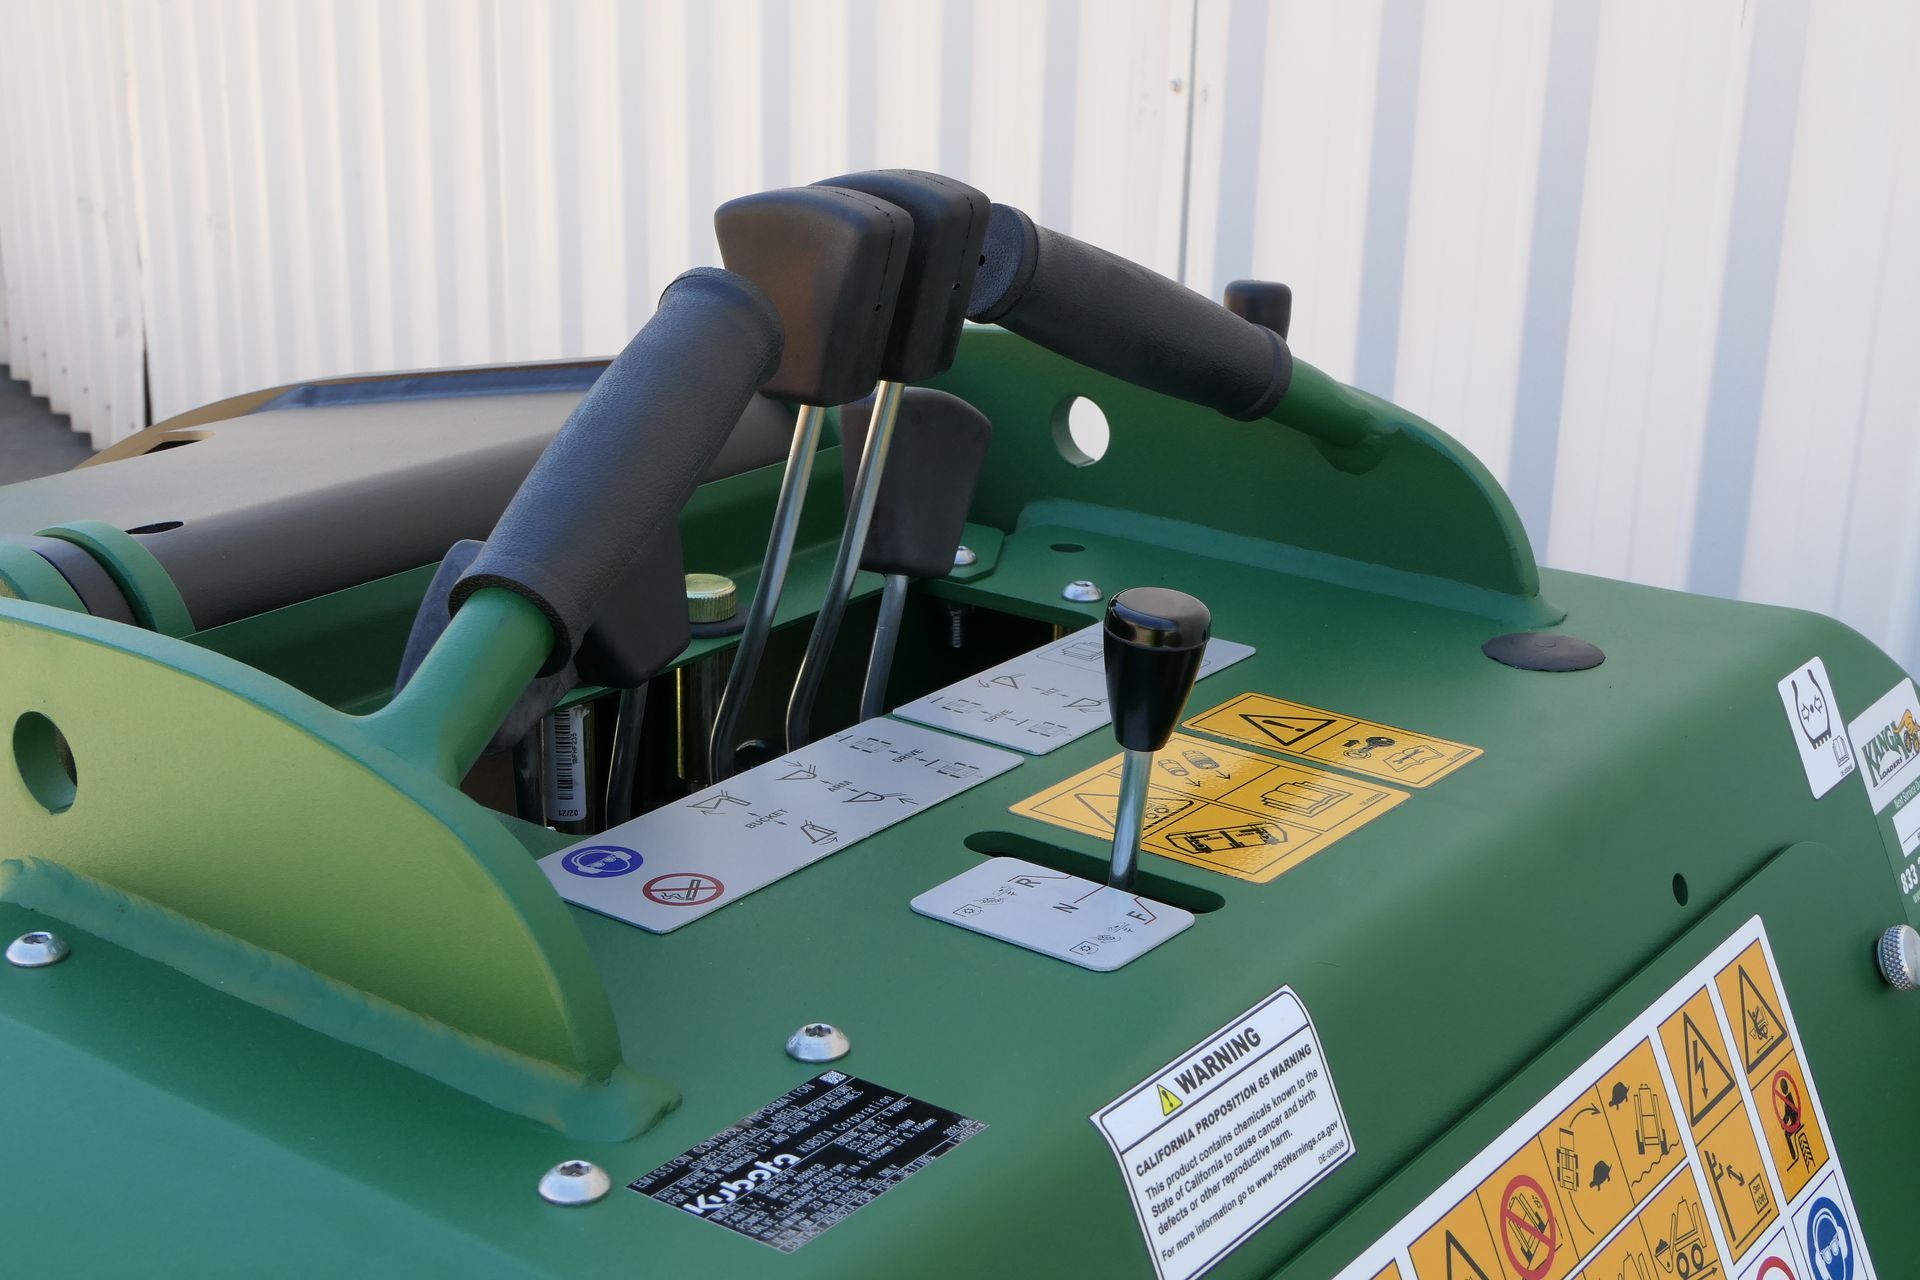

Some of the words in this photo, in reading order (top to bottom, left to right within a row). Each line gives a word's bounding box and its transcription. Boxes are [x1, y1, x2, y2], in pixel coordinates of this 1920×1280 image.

[983, 708, 1011, 723] DRIVE
[892, 748, 924, 764] DRIVE
[1879, 757, 1903, 780] LOADERS
[827, 779, 853, 793] ARM
[558, 809, 579, 817] 02/21
[744, 808, 789, 830] BUCKET
[1015, 878, 1042, 889] R
[1900, 863, 1918, 894] 833
[1052, 902, 1079, 913] N
[1126, 910, 1147, 921] F
[1174, 1027, 1262, 1095] WARNING
[796, 1130, 836, 1151] KUBOTA
[831, 1095, 896, 1130] Corporation
[1136, 1128, 1195, 1176] CALIFORNIA
[1195, 1082, 1257, 1134] PROPOSITION
[1258, 1073, 1269, 1088] 65
[1270, 1044, 1311, 1080] WARNING
[633, 1154, 693, 1187] EMISSION
[691, 1126, 742, 1153] CONTROL
[744, 1084, 814, 1122] INFORMATION
[656, 1186, 680, 1198] THIS
[677, 1170, 708, 1186] ENGINE
[705, 1155, 733, 1170] MEETS
[729, 1144, 752, 1156] 2021
[771, 1111, 809, 1131] EMISSION
[805, 1085, 853, 1111] REGULATIONS
[688, 1126, 763, 1168] (SUPPLEMENTAL
[763, 1105, 800, 1124] LABEL)
[833, 1130, 861, 1144] ENGINE
[1145, 1182, 1164, 1200] This
[1166, 1156, 1198, 1189] product
[1199, 1132, 1232, 1161] contains
[1234, 1104, 1271, 1136] chemicals
[1272, 1085, 1296, 1107] known
[1297, 1079, 1305, 1089] to
[1306, 1069, 1318, 1083] the
[667, 1193, 687, 1204] FOR
[720, 1151, 759, 1172] NONROAD
[769, 1133, 790, 1143] AND
[786, 1121, 810, 1133] CARB
[1152, 1197, 1174, 1217] State
[1175, 1186, 1184, 1200] of
[1185, 1160, 1223, 1192] California
[1224, 1153, 1232, 1164] to
[1234, 1135, 1256, 1156] cause
[1258, 1115, 1282, 1138] cancer
[1284, 1101, 1298, 1119] and
[1298, 1089, 1316, 1108] birth
[681, 1150, 800, 1215] Kubota
[794, 1219, 813, 1229] LOW
[809, 1203, 838, 1219] SULFUR
[834, 1188, 861, 1203] DIESEL
[859, 1177, 880, 1187] FUEL
[877, 1164, 900, 1176] ONLY
[820, 1189, 840, 1200] DEG
[837, 1176, 861, 1189] BTDC
[1159, 1207, 1188, 1235] defects
[1190, 1198, 1198, 1211] or
[1200, 1182, 1220, 1203] other
[1222, 1146, 1270, 1186] reproductive
[1270, 1130, 1292, 1149] harm.
[1162, 1246, 1175, 1261] For
[1176, 1232, 1195, 1251] more
[1195, 1199, 1237, 1235] information
[1238, 1192, 1247, 1205] go
[1247, 1185, 1255, 1194] to
[1256, 1121, 1337, 1188] www.P65Warnings.ca.gov
[711, 1201, 743, 1219] MODEL
[736, 1210, 768, 1228] POWER
[747, 1217, 776, 1233] VALVE
[784, 1225, 823, 1248] CONTACT
[821, 1204, 857, 1224] KUBOTA
[854, 1192, 875, 1203] FOR
[873, 1178, 897, 1191] FUEL
